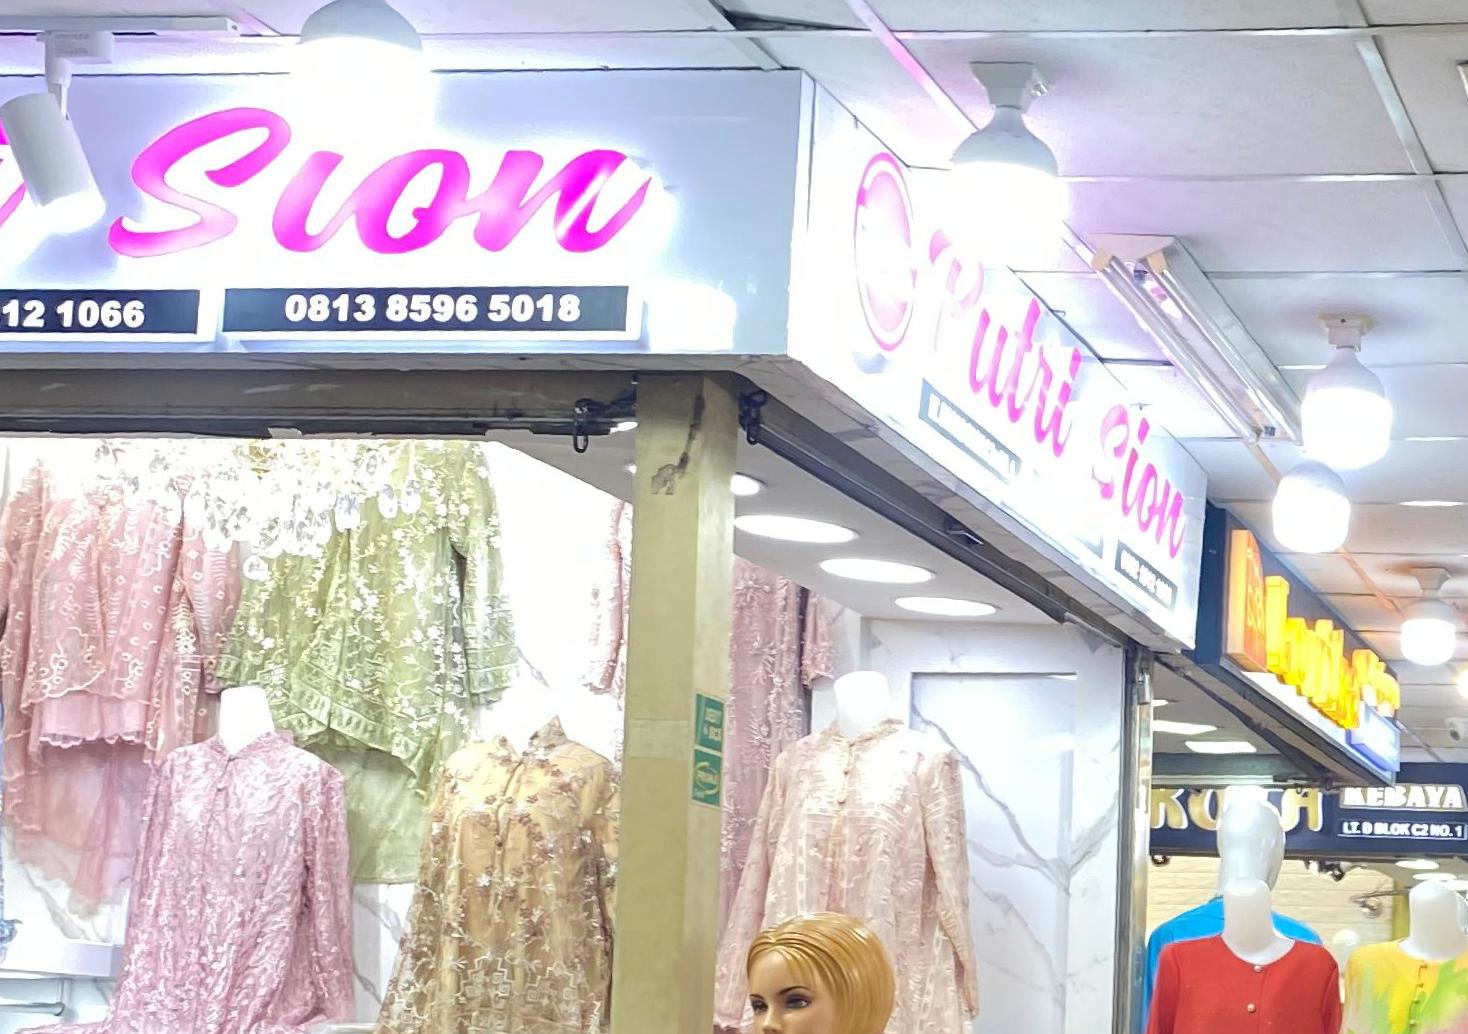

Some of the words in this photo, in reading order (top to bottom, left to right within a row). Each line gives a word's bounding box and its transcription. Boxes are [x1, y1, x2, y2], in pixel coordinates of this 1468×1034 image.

[108, 107, 652, 257] Sion
[56, 298, 146, 329] 1066
[284, 295, 376, 323] 0813
[385, 294, 476, 322] 8596
[487, 294, 582, 323] 5018
[1342, 784, 1465, 809] KEBAYA
[1373, 822, 1411, 836] BLOK
[1455, 825, 1463, 838] 1
